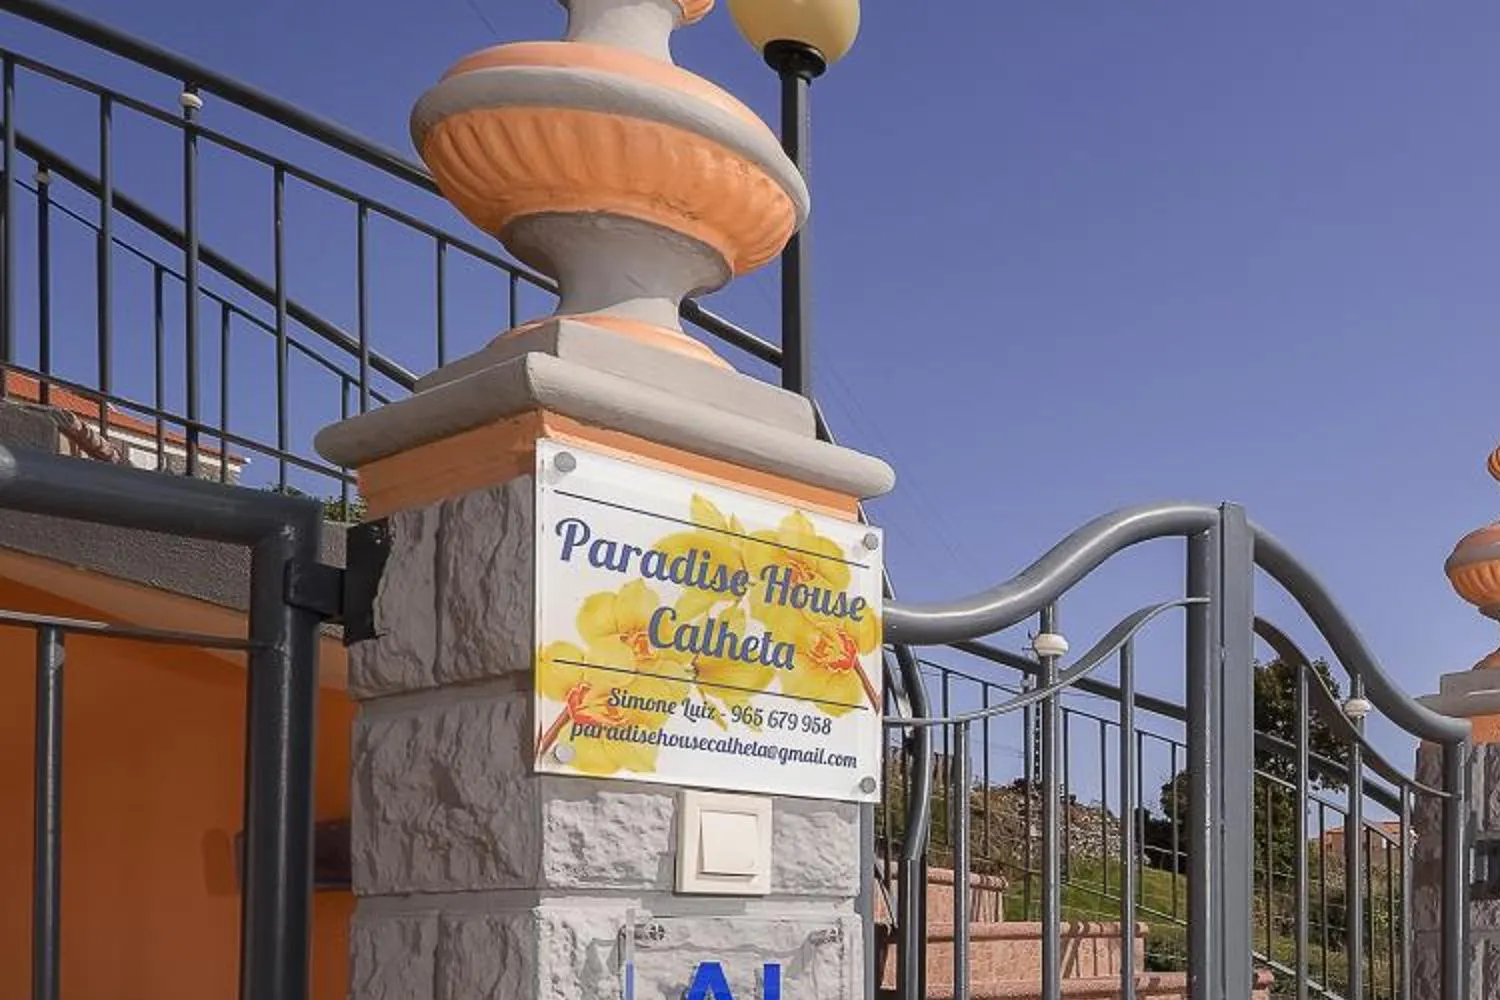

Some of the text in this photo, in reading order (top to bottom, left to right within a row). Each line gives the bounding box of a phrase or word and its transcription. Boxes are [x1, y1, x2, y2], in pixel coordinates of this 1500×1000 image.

[555, 517, 867, 622] Paradise House
[650, 606, 796, 671] Calheta
[607, 687, 678, 716] Simone
[681, 697, 717, 723] Luiz
[731, 704, 763, 727] 965
[767, 709, 799, 731] 679
[801, 713, 833, 736] 958
[569, 721, 858, 769] paradisehousecalheta@gmail.com
